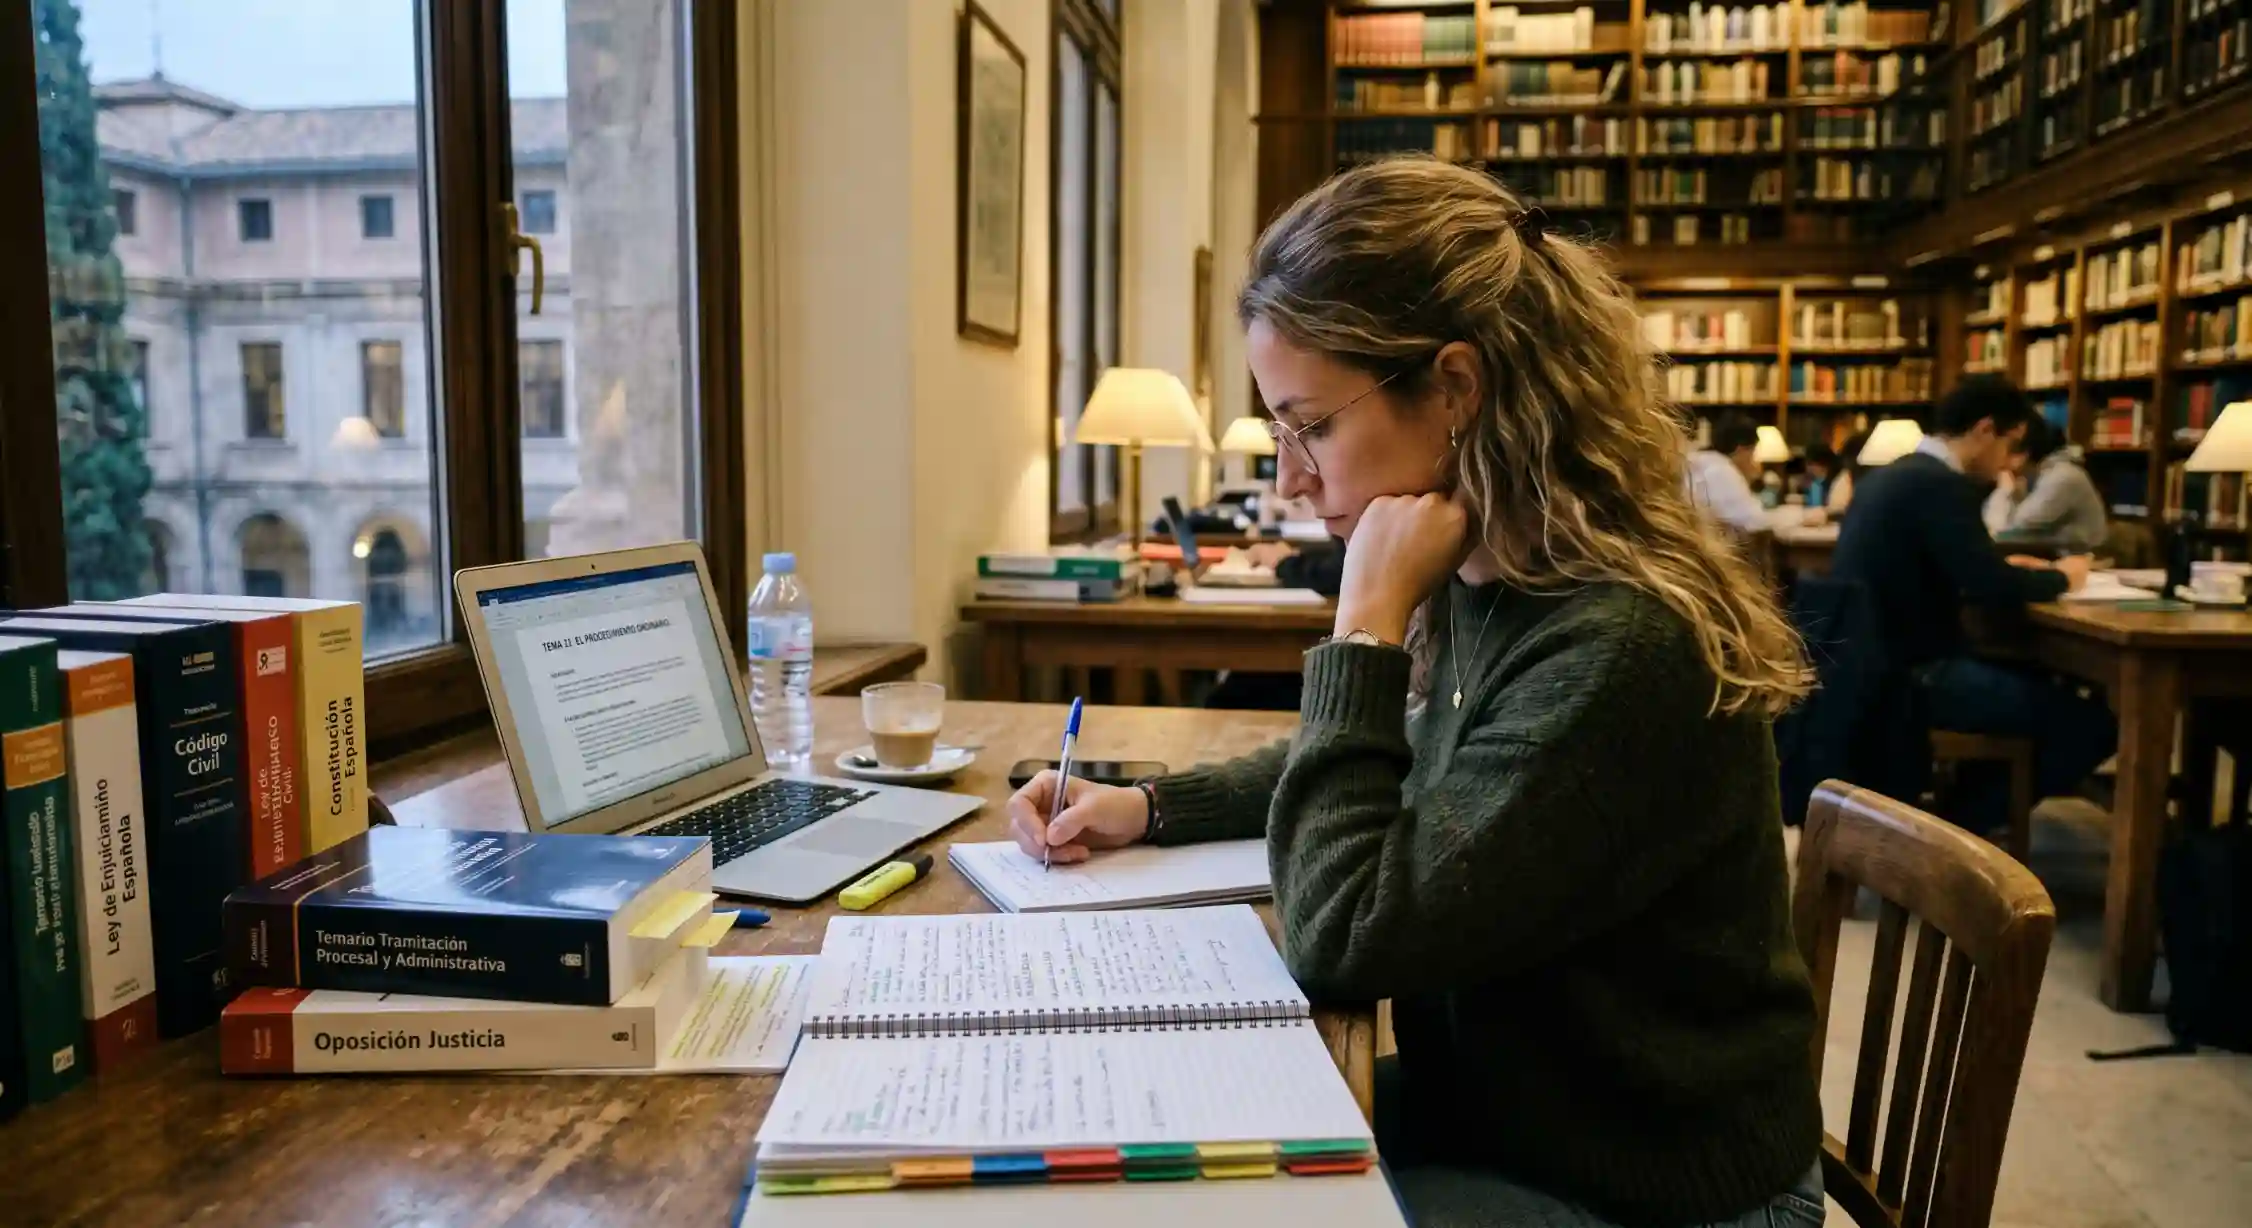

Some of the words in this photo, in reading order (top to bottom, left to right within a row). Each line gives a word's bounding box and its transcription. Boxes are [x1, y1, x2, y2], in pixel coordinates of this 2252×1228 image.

[541, 640, 563, 652] TEMA
[175, 732, 228, 756] Código
[341, 696, 358, 778] Española
[187, 752, 220, 776] Civil
[325, 699, 342, 816] Constitución
[117, 814, 138, 903] Española
[103, 895, 117, 917] de
[107, 919, 122, 957] Ley
[316, 930, 375, 947] Temario
[378, 932, 468, 951] Tramitación
[316, 949, 378, 967] Procesal
[383, 955, 391, 970] y
[395, 953, 506, 973] Administrativa
[314, 1031, 421, 1055] Oposición
[428, 1029, 506, 1049] Justicia
